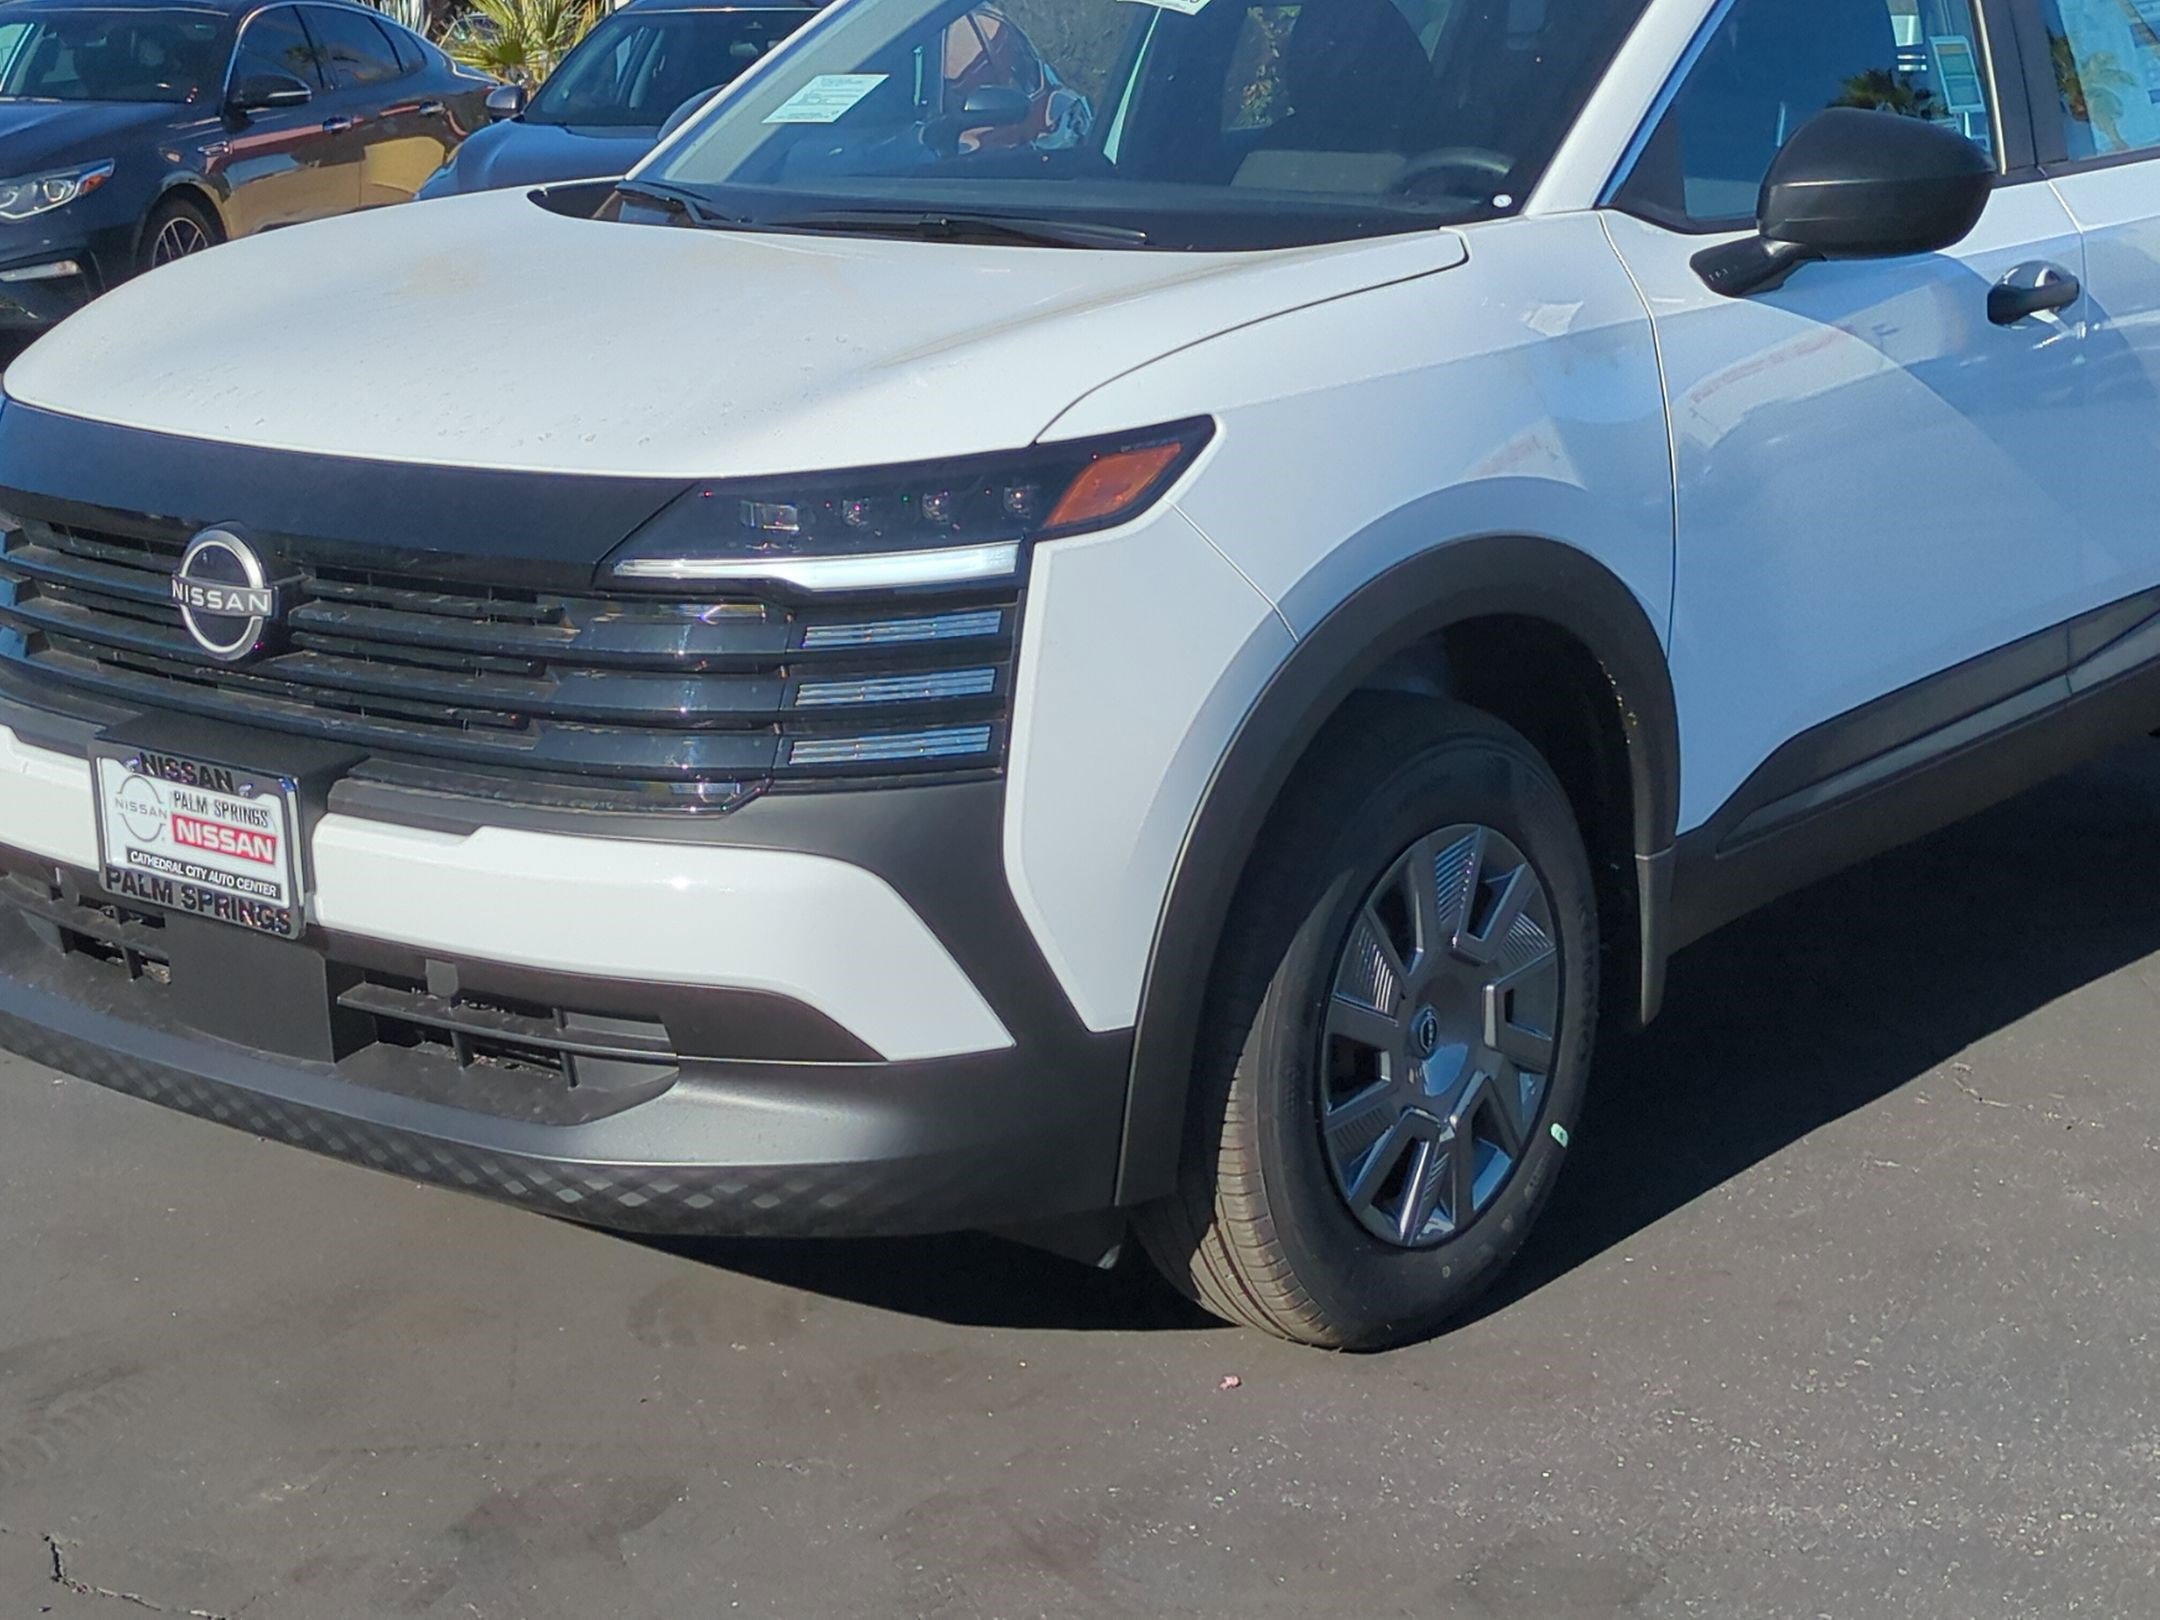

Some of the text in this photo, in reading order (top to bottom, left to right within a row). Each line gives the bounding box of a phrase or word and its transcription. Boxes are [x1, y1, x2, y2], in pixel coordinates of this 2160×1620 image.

[171, 578, 269, 612] NISSAN
[139, 751, 235, 792] NISSAN
[114, 797, 168, 819] NISSAN
[173, 790, 268, 827] PALM SPRINGS
[175, 816, 274, 862] NISSAN
[105, 866, 174, 904] PALM
[130, 850, 277, 898] CATHEDRAL CITY AUTO CENTER
